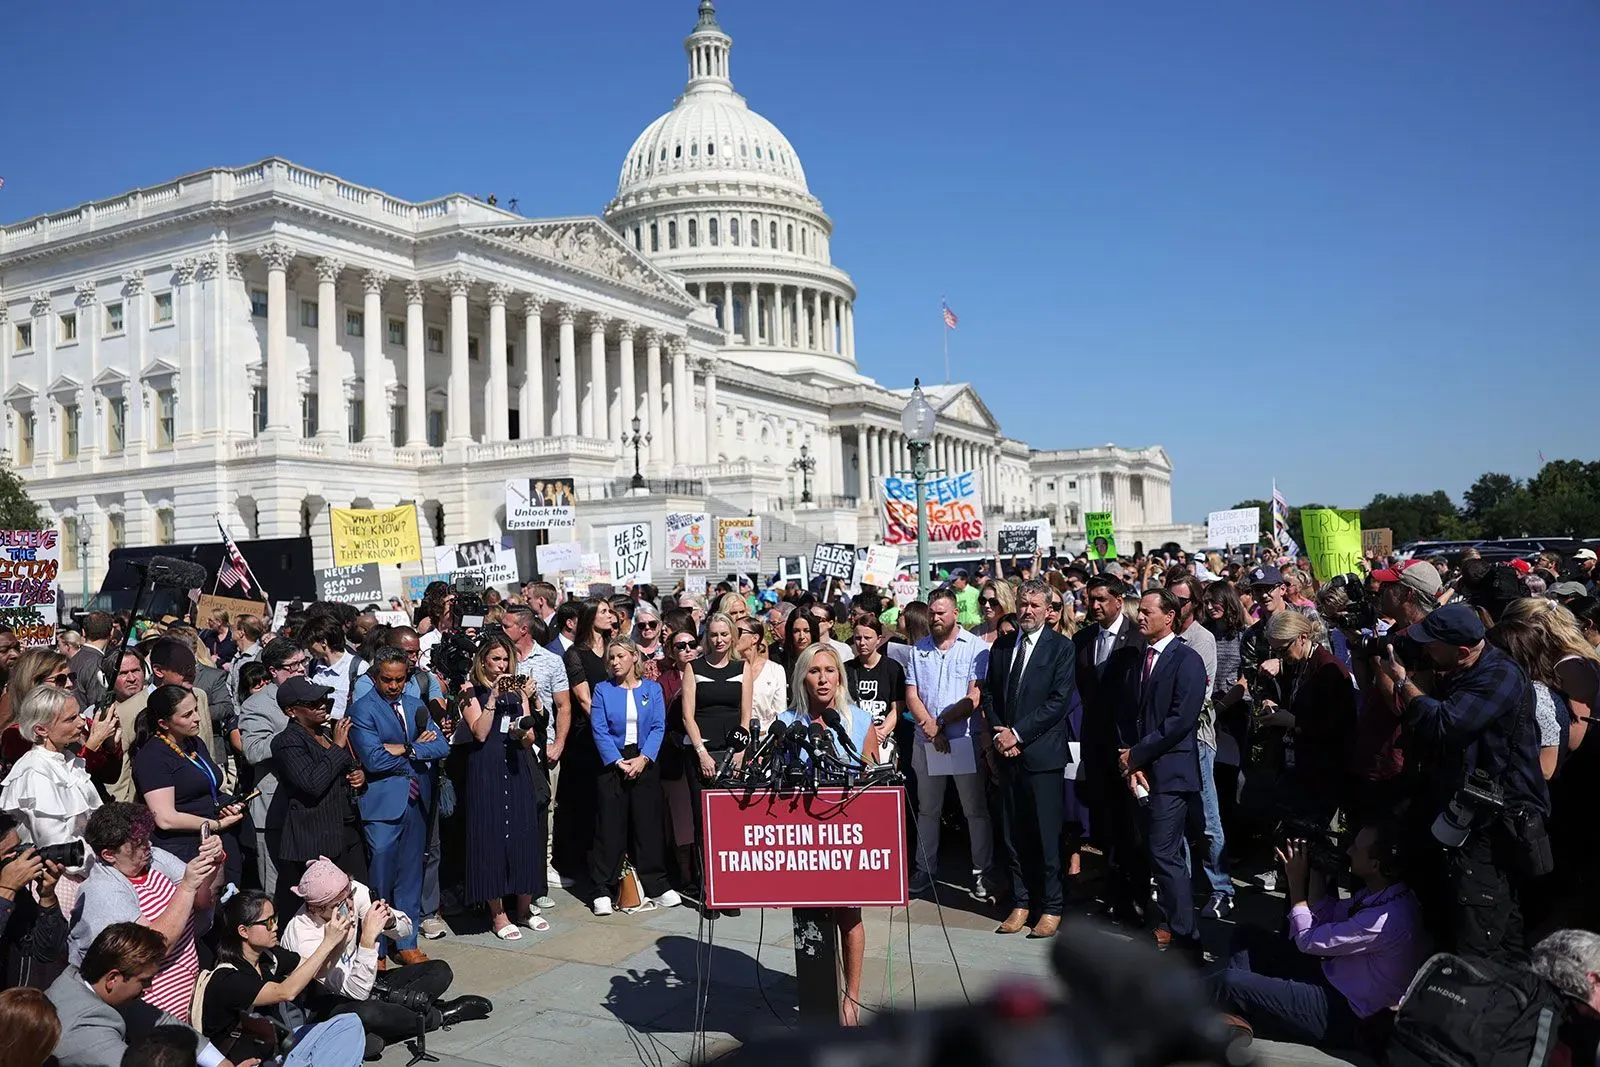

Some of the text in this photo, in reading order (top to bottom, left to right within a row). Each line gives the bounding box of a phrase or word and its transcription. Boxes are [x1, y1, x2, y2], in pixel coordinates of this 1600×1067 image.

[885, 471, 975, 505] BEIEVE
[351, 512, 397, 524] WHAT DID
[514, 507, 568, 517] Unlock the
[1086, 513, 1111, 521] TRUMP
[343, 520, 407, 536] THEY KNOW?
[508, 518, 576, 529] Epstein Files!
[719, 519, 754, 528] PEDOPHILE
[1305, 511, 1360, 533] TRUST
[614, 524, 644, 547] HE IS
[883, 520, 983, 545] SUViVORS
[1087, 528, 1110, 536] FILES
[353, 537, 400, 549] WHEN DID
[617, 539, 648, 557] ON the
[1308, 535, 1336, 551] THE
[6, 548, 37, 561] THE
[340, 544, 415, 560] THEY KNOW IT?
[816, 544, 855, 565] RELEASE
[489, 564, 507, 573] the
[615, 551, 649, 580] LIST!
[671, 558, 707, 569] PEDO-MAN
[820, 561, 852, 580] FILES
[323, 564, 365, 578] NEUTER
[486, 571, 516, 583] Files!
[0, 578, 52, 594] ELEASE
[323, 577, 363, 589] GRAND
[324, 586, 347, 595] OLD
[324, 590, 382, 603] PEDOPHILES
[0, 594, 19, 607] HE
[859, 700, 887, 713] WER
[733, 730, 748, 746] svt
[743, 823, 864, 846] EPSTEIN FILES
[718, 848, 892, 872] TRANSPARENCY ACT
[1427, 985, 1467, 1005] PANDORA
